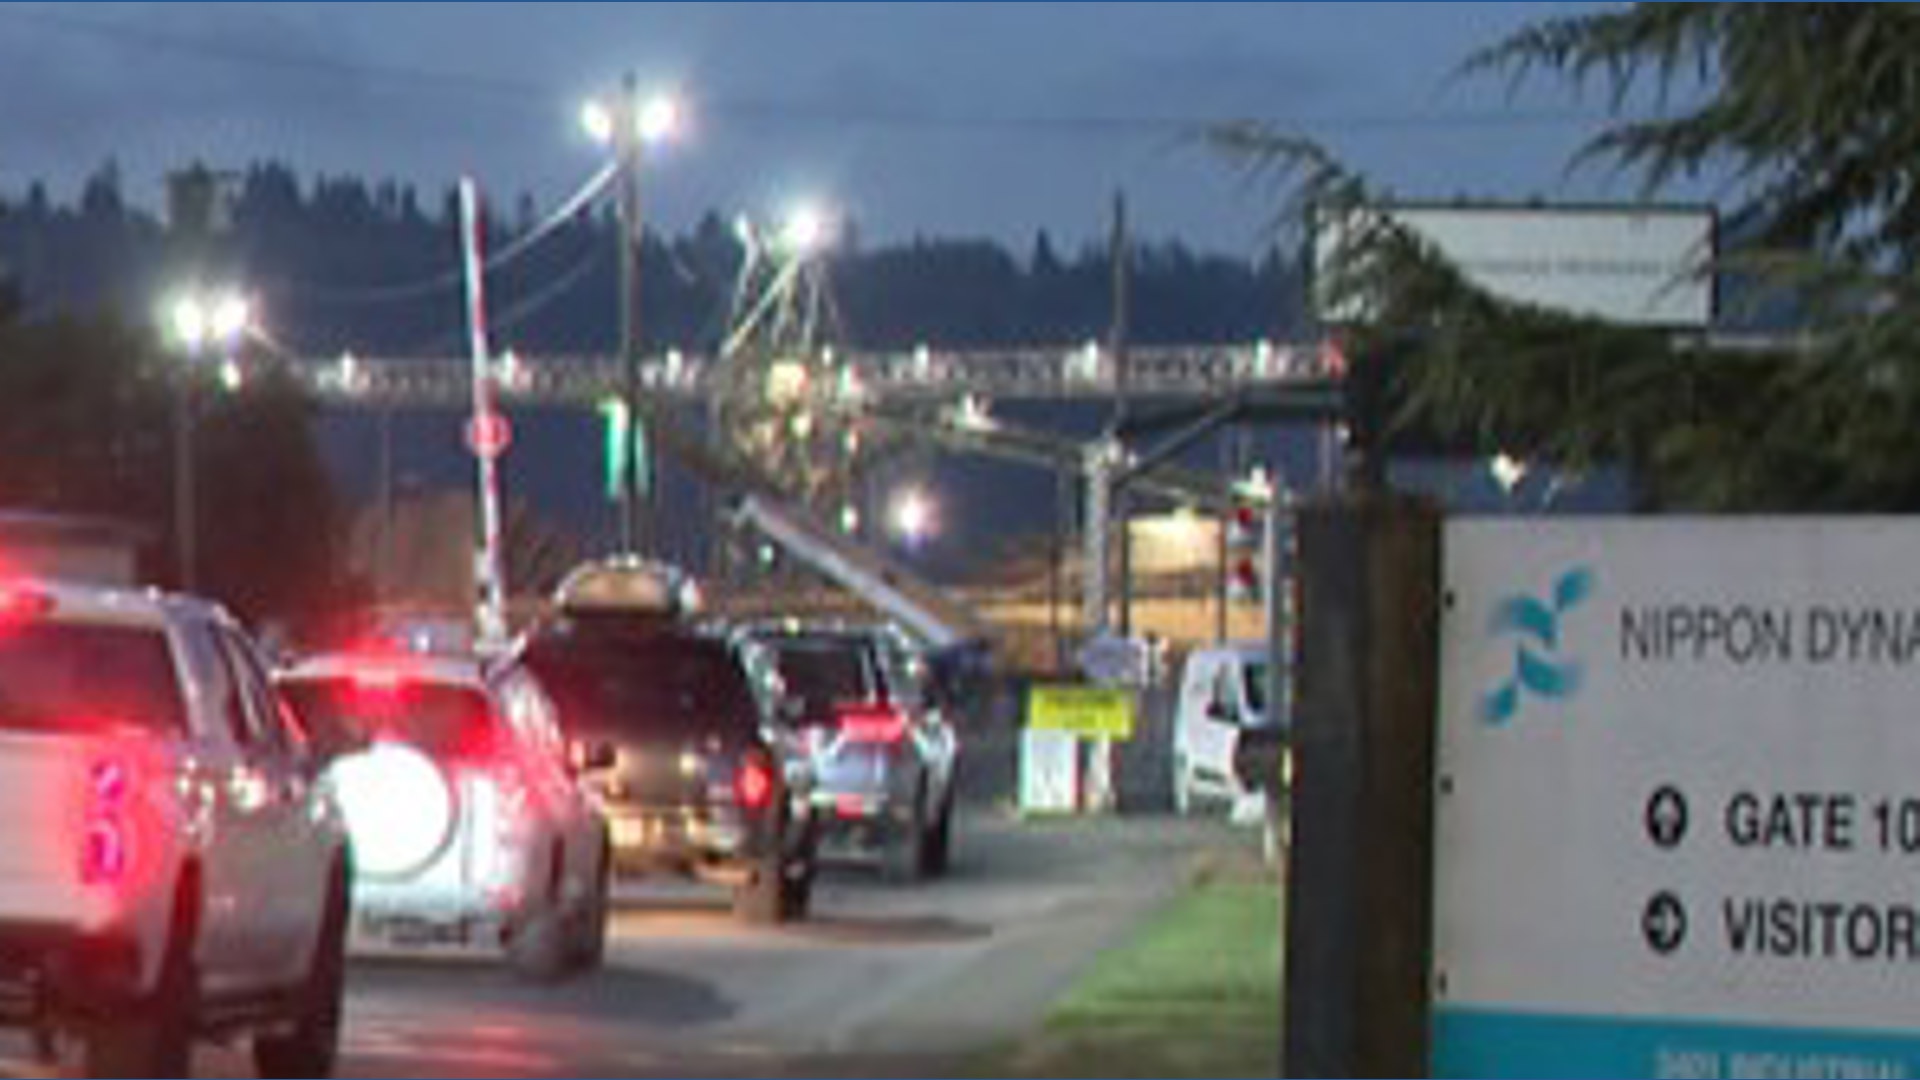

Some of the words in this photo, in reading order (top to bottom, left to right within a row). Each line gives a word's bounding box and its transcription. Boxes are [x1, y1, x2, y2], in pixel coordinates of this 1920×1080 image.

[1620, 605, 1792, 663] NIPPON
[1725, 792, 1853, 849] GATE
[1872, 797, 1920, 853] 10
[1724, 897, 1920, 961] VISITOR
